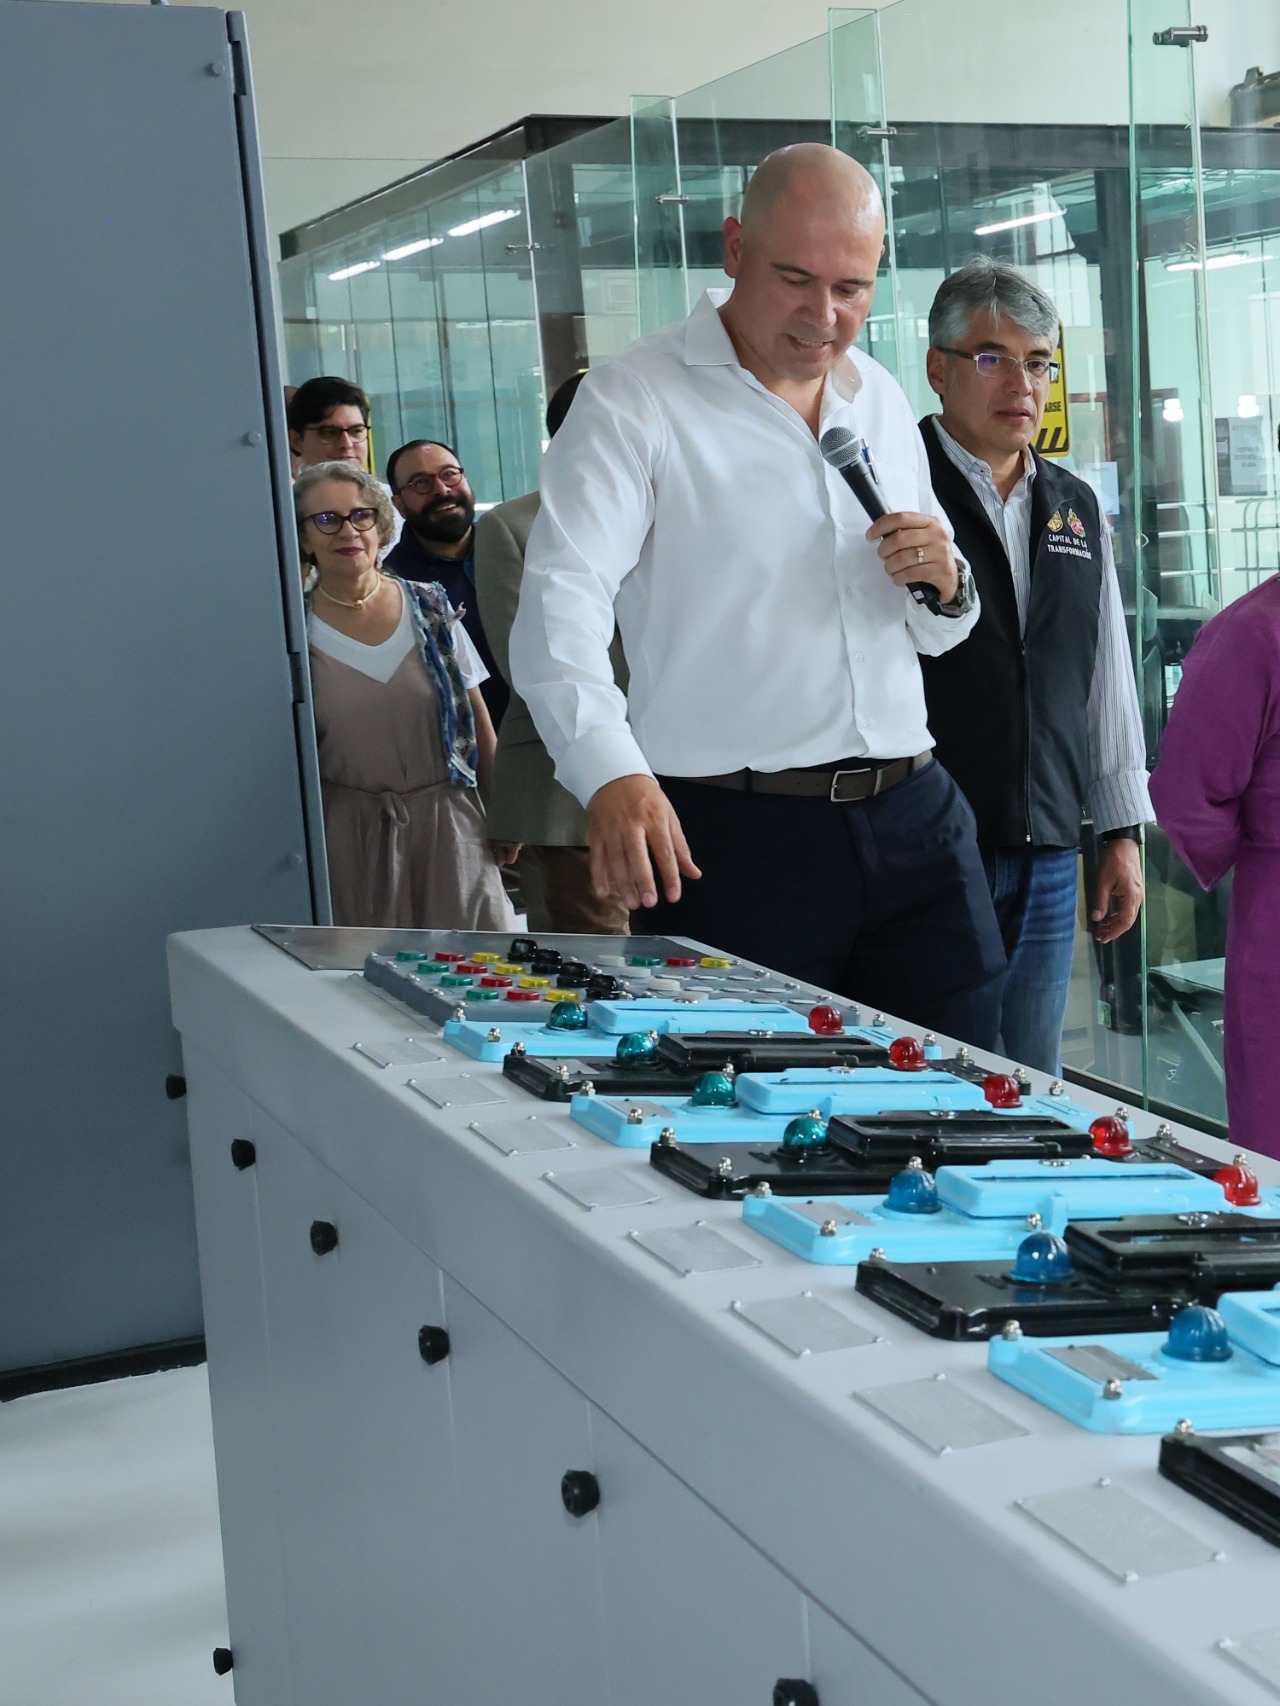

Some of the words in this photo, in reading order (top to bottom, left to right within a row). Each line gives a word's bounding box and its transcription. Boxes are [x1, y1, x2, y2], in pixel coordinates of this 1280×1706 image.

[1048, 534, 1072, 545] CAPITAL
[1073, 537, 1080, 546] DE
[1080, 539, 1088, 549] LA
